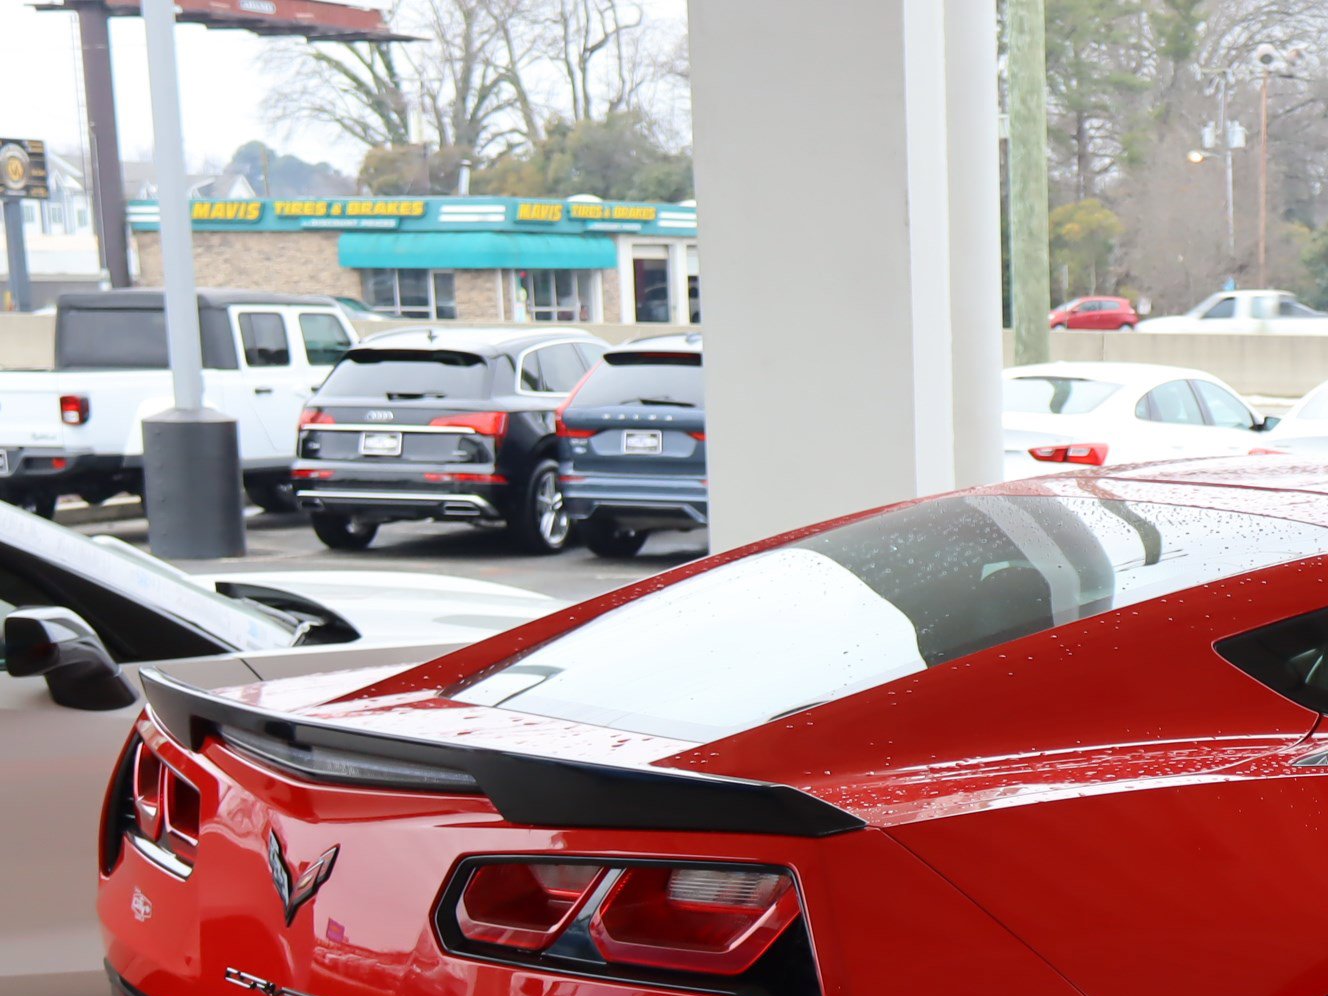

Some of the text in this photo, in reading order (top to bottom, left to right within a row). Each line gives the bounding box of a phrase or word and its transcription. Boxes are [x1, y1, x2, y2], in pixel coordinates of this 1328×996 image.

[192, 201, 261, 219] MAVIS
[273, 201, 327, 216] TIRES
[346, 201, 425, 216] BRAKES
[517, 203, 563, 221] MAVIS
